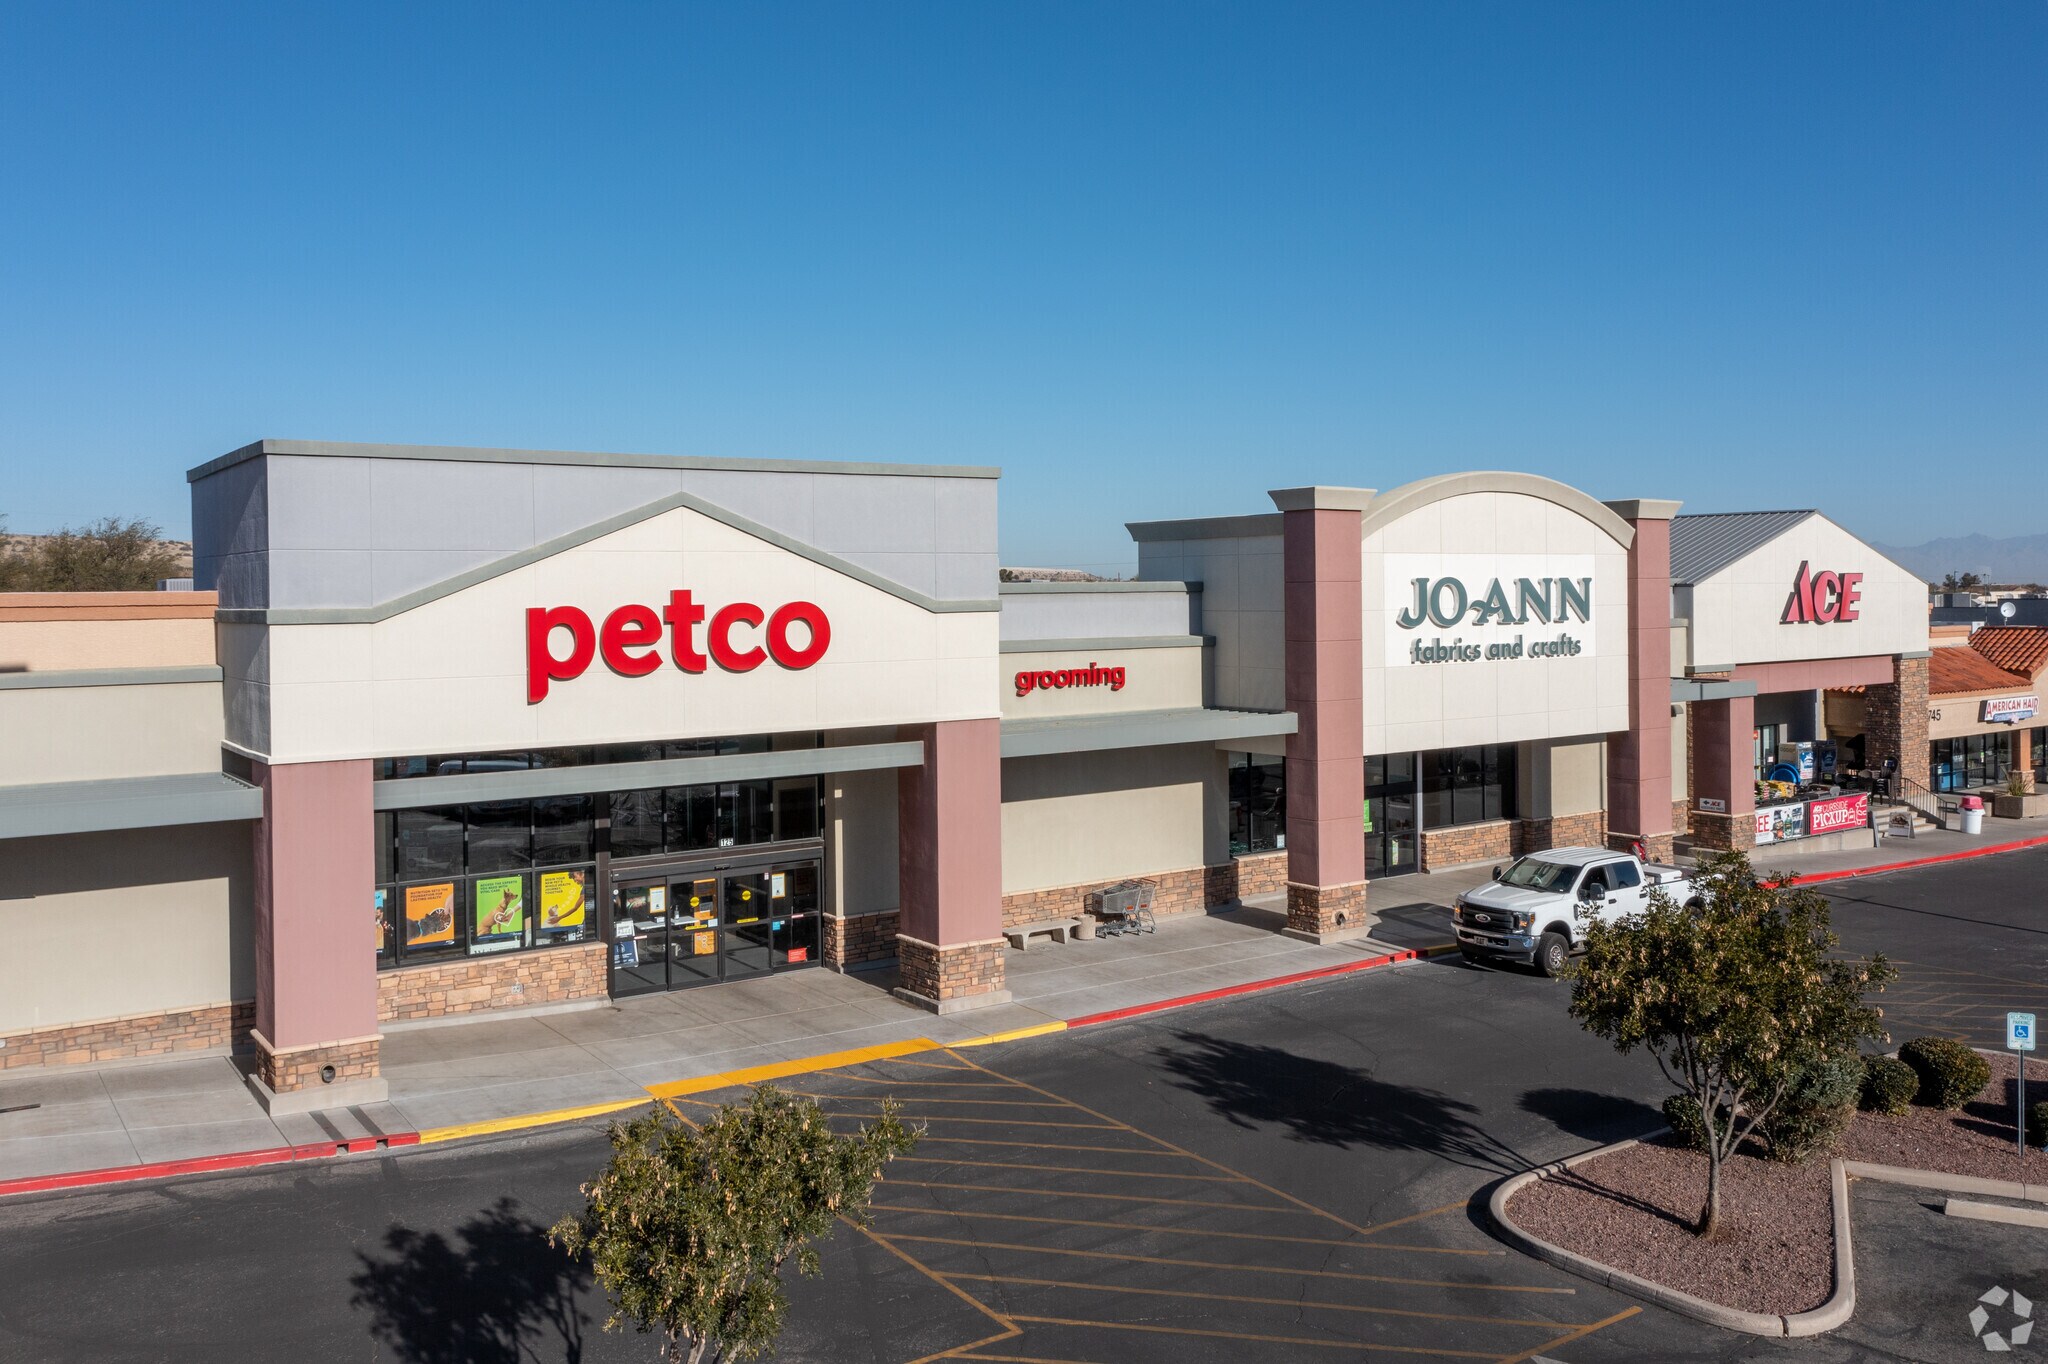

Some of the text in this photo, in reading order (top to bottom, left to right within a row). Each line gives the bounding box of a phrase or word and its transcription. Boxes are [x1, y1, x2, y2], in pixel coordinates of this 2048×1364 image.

[1397, 576, 1592, 629] JO-ANN
[1779, 560, 1863, 625] ACE
[526, 589, 831, 706] petco
[1410, 632, 1582, 664] fabrics and crafts
[1015, 661, 1125, 697] grooming
[1986, 700, 2020, 718] AMERICAN
[2022, 697, 2039, 713] HAIR
[1812, 800, 1848, 814] ACE CURBSIDE
[1812, 809, 1848, 828] PICKUP
